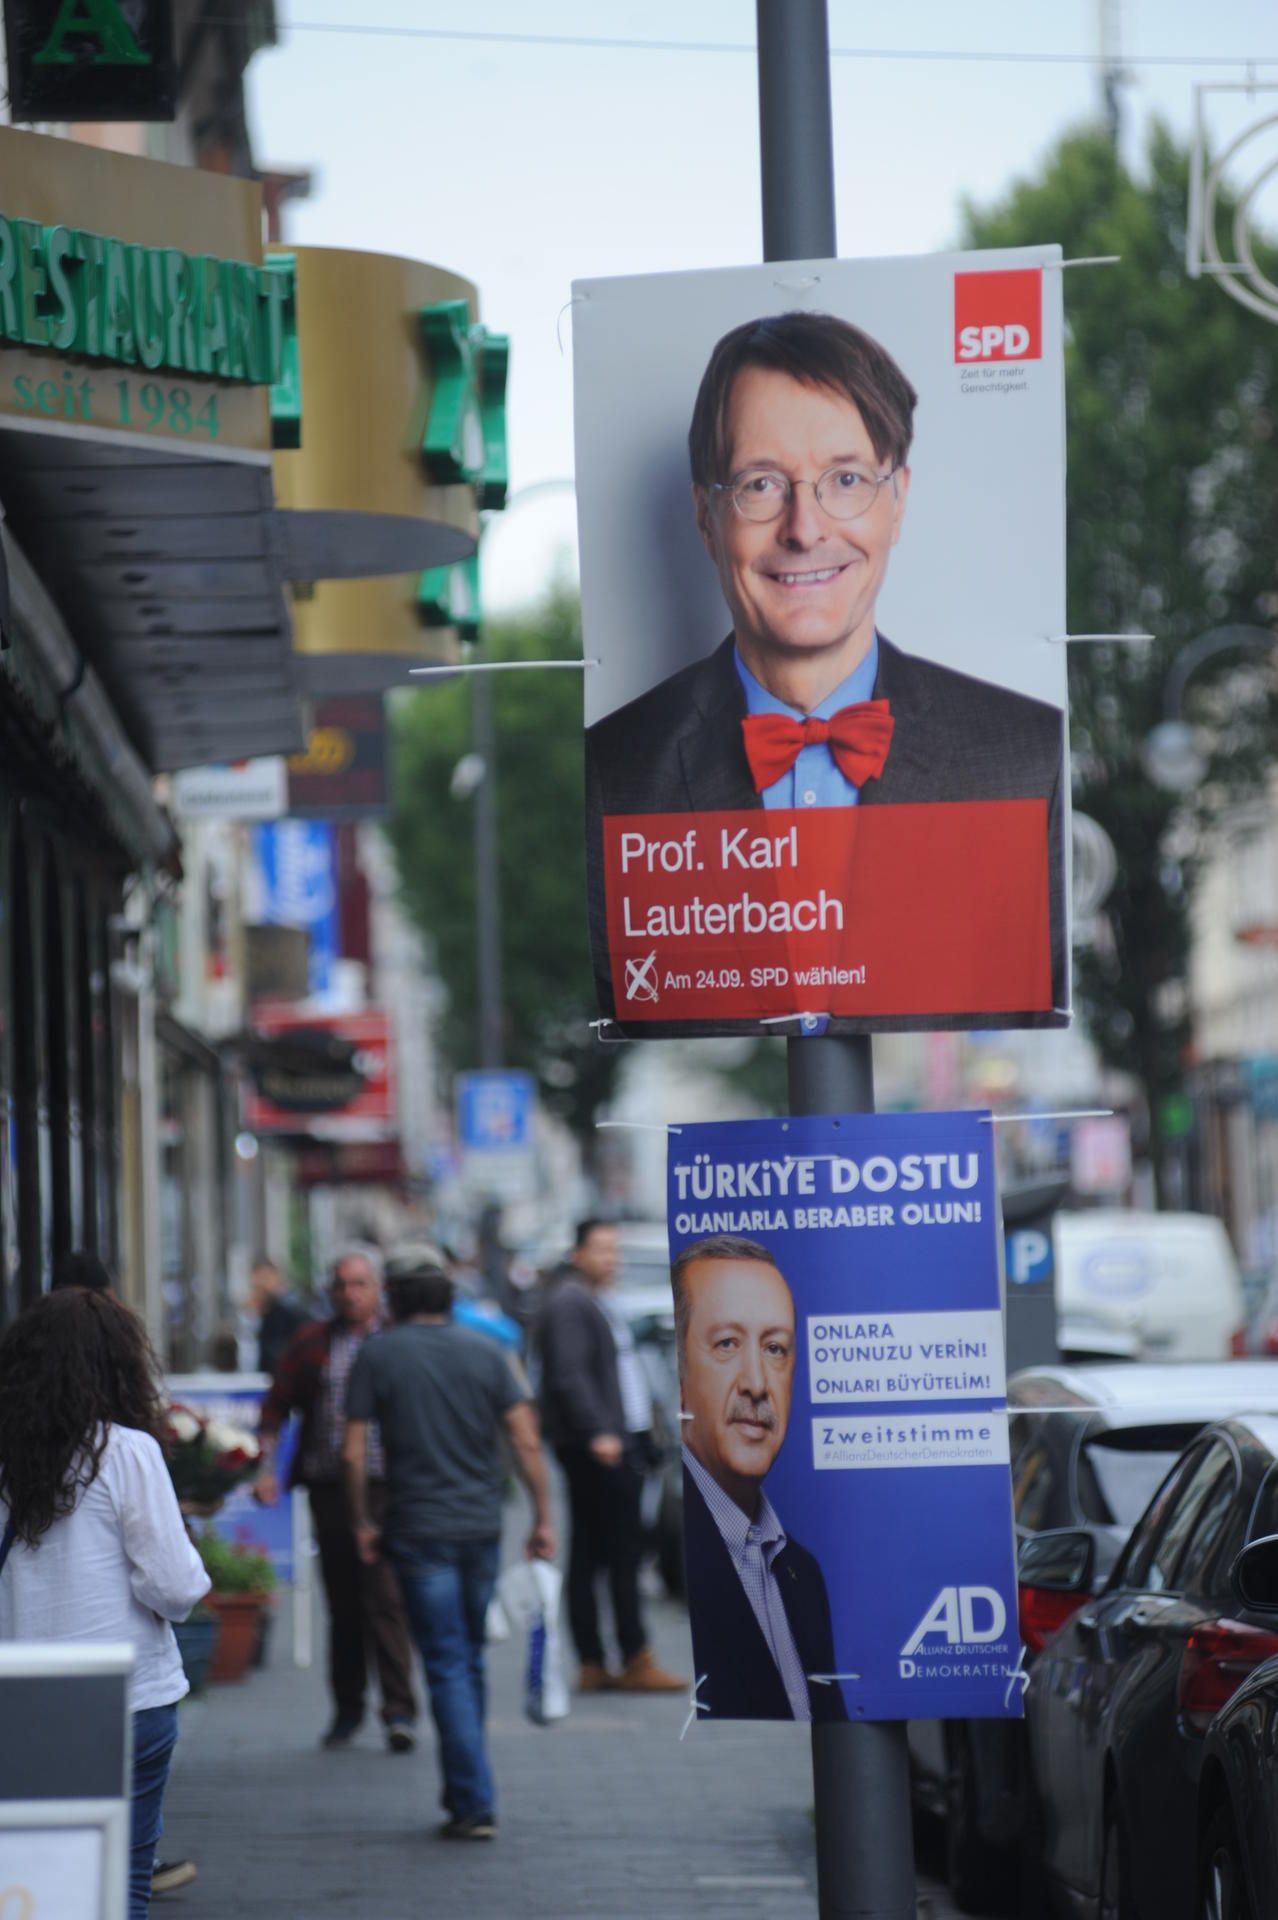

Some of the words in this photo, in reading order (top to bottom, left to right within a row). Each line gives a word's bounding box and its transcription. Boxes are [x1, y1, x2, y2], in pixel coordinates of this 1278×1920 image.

[959, 324, 1030, 359] SPD
[960, 369, 979, 380] Zeit
[982, 367, 996, 379] für
[999, 366, 1024, 378] mehr
[960, 381, 1030, 394] Gerechtigkeit.
[11, 370, 96, 421] seit
[114, 379, 221, 439] 1984
[621, 830, 704, 874] Prof.
[721, 826, 798, 870] Karl
[623, 889, 844, 937] Lauterbach
[664, 971, 692, 990] Am
[696, 969, 745, 989] 24.09.
[751, 968, 789, 987] SPD
[795, 965, 866, 986] wählen!
[831, 1153, 979, 1194] DOSTU
[675, 1209, 789, 1235] OLANLARLA
[794, 1204, 895, 1230] BERABER
[901, 1200, 982, 1226] OLUN!
[1012, 1229, 1049, 1285] P
[813, 1323, 895, 1341] ONLARA
[814, 1345, 912, 1363] OYUNUZU
[920, 1338, 987, 1360] VERİN!
[816, 1376, 880, 1394] ONLARI
[887, 1371, 991, 1392] BÜYÜTELİM!
[822, 1424, 991, 1445] Zweitstimme
[823, 1446, 993, 1463] #AllianzDeutscherDemokraten
[900, 1586, 1007, 1656] AD
